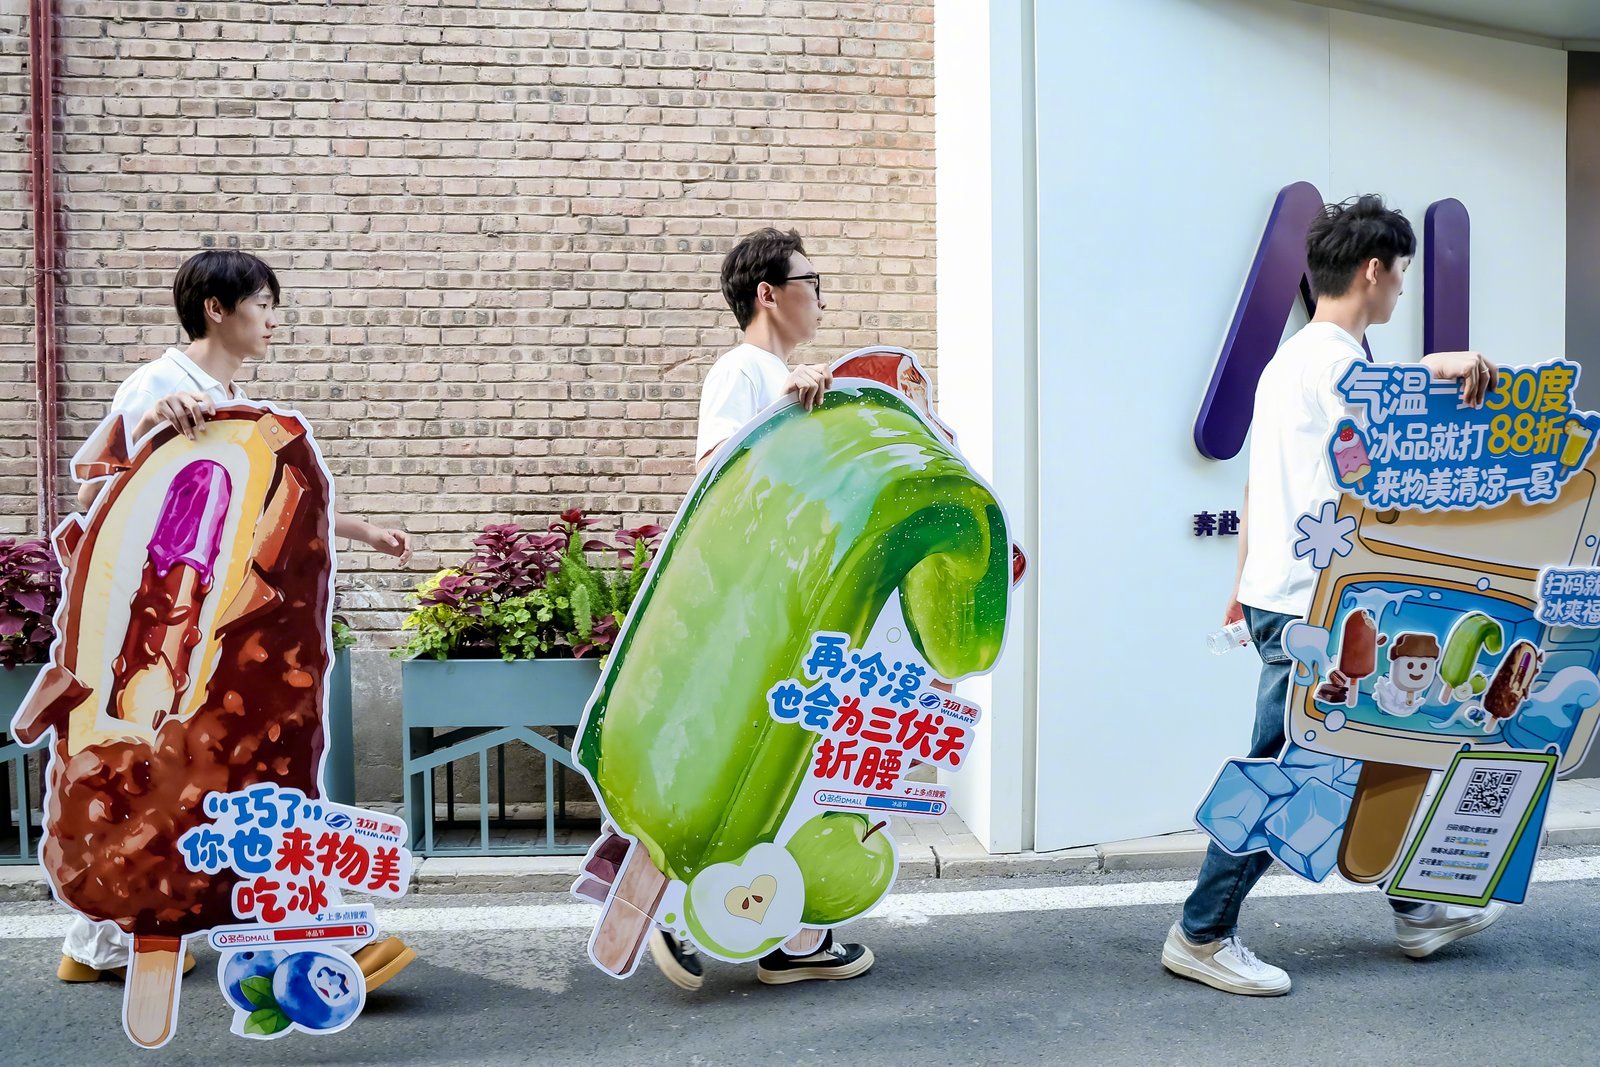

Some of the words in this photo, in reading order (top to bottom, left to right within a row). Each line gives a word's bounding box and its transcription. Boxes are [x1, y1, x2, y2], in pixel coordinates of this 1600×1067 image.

[1341, 365, 1574, 424] 气温一30度
[1368, 413, 1565, 464] 冰品就打88折
[1373, 461, 1558, 505] 来物美清凉一夏
[806, 636, 926, 708] 再冷漠
[772, 682, 965, 766] 也会为三伏天
[940, 708, 974, 724] WUMART
[813, 738, 903, 790] 折腰
[183, 827, 400, 893] 你也来物美
[354, 828, 400, 842] WUMART
[237, 875, 328, 923] 吃冰
